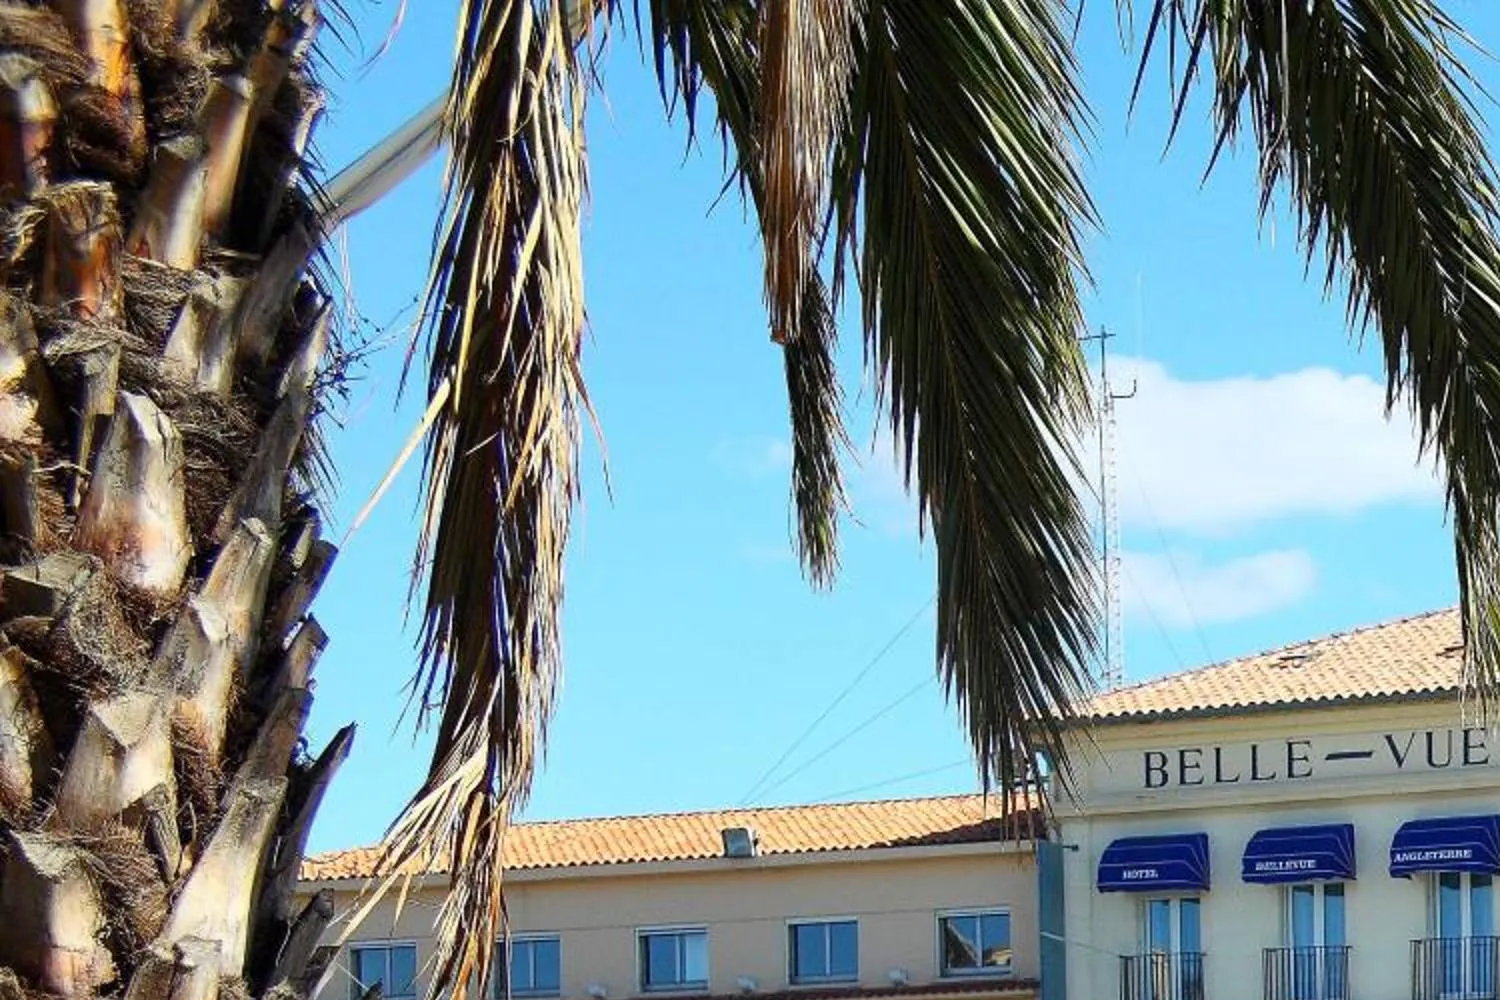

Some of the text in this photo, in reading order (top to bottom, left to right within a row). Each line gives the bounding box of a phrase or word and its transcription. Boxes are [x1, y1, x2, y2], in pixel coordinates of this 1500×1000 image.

[1394, 849, 1472, 863] ANGLETERRE
[1255, 859, 1316, 872] BELLEVUE
[1123, 868, 1158, 880] HOTEL
